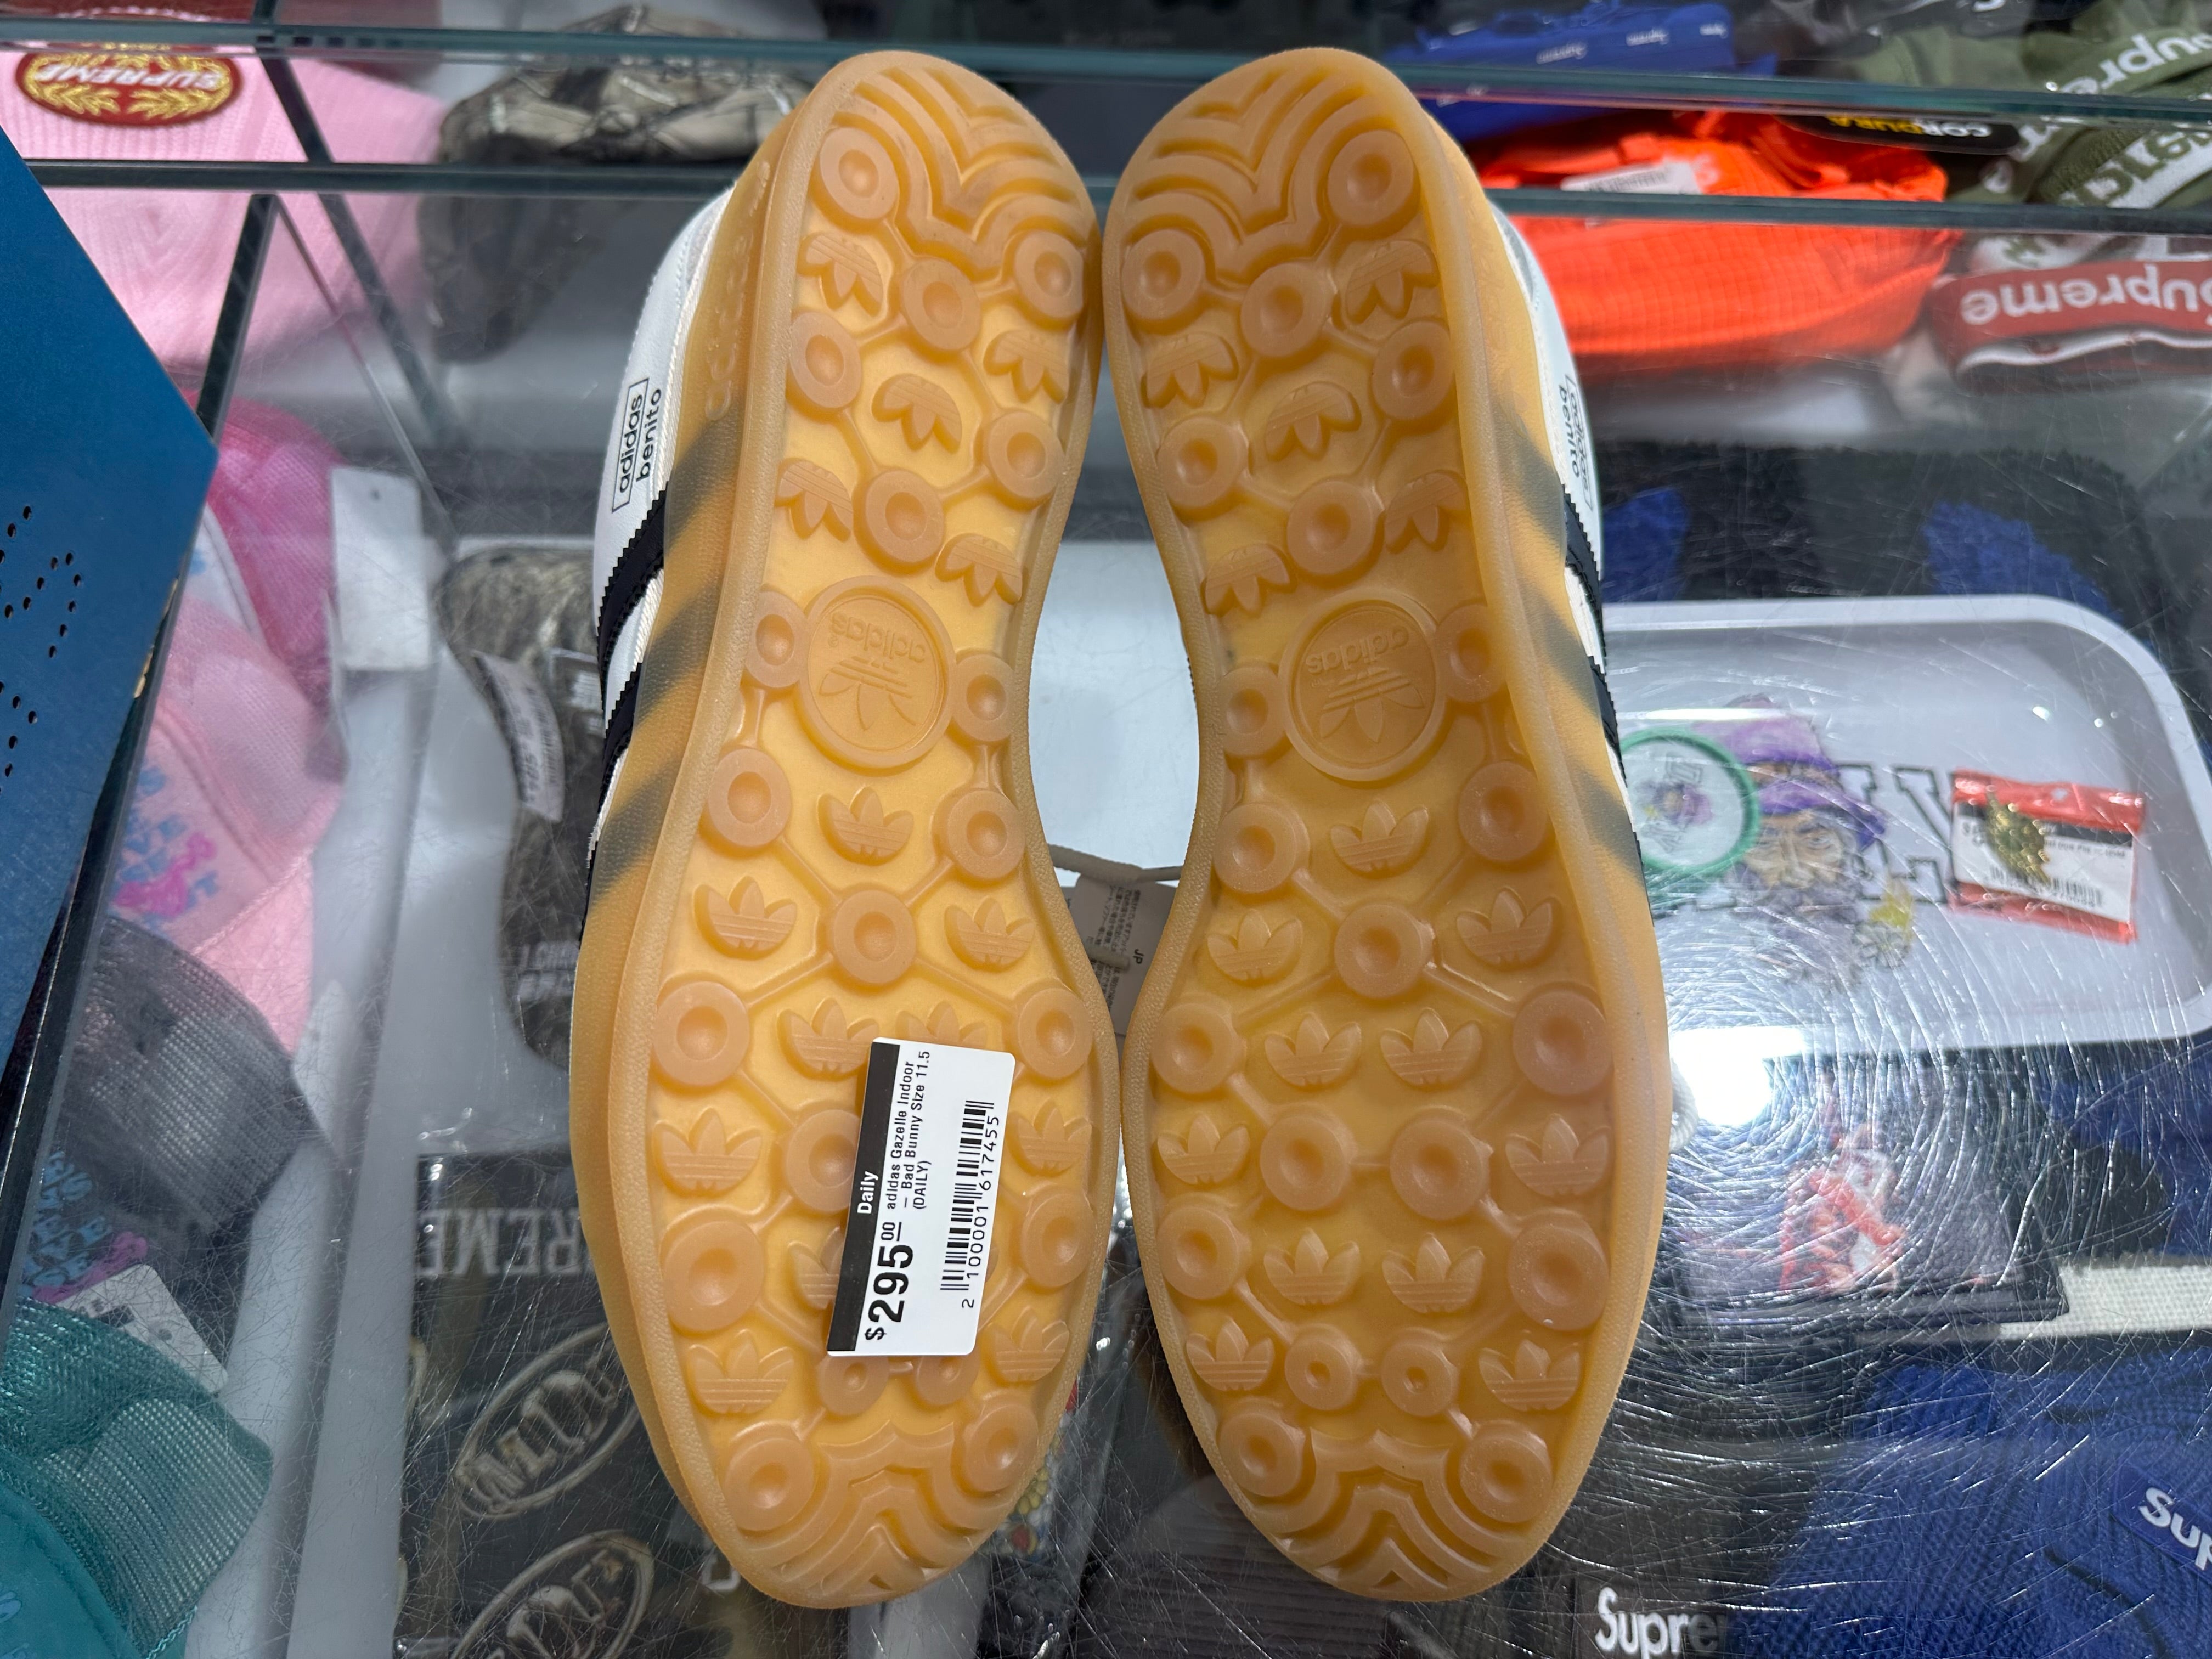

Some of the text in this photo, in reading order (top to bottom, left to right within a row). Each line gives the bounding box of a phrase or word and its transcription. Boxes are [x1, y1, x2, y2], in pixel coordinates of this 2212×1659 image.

[34, 61, 222, 91] SUPREME
[619, 394, 643, 493] adidas
[636, 388, 662, 482] benito
[1559, 384, 1580, 478] benito
[1570, 392, 1589, 492] adidas
[1305, 625, 1409, 676] adidas
[1133, 948, 1145, 965] JP
[916, 1051, 930, 1077] 11.5
[911, 1085, 925, 1110] Size
[887, 1061, 915, 1210] adidas Gazelle Indoor
[904, 1115, 923, 1158] Bunny
[857, 1171, 879, 1214] Daily
[901, 1164, 915, 1189] Bad
[912, 1160, 932, 1209] (DAILY)
[962, 1115, 1000, 1308] 2 100001 617455
